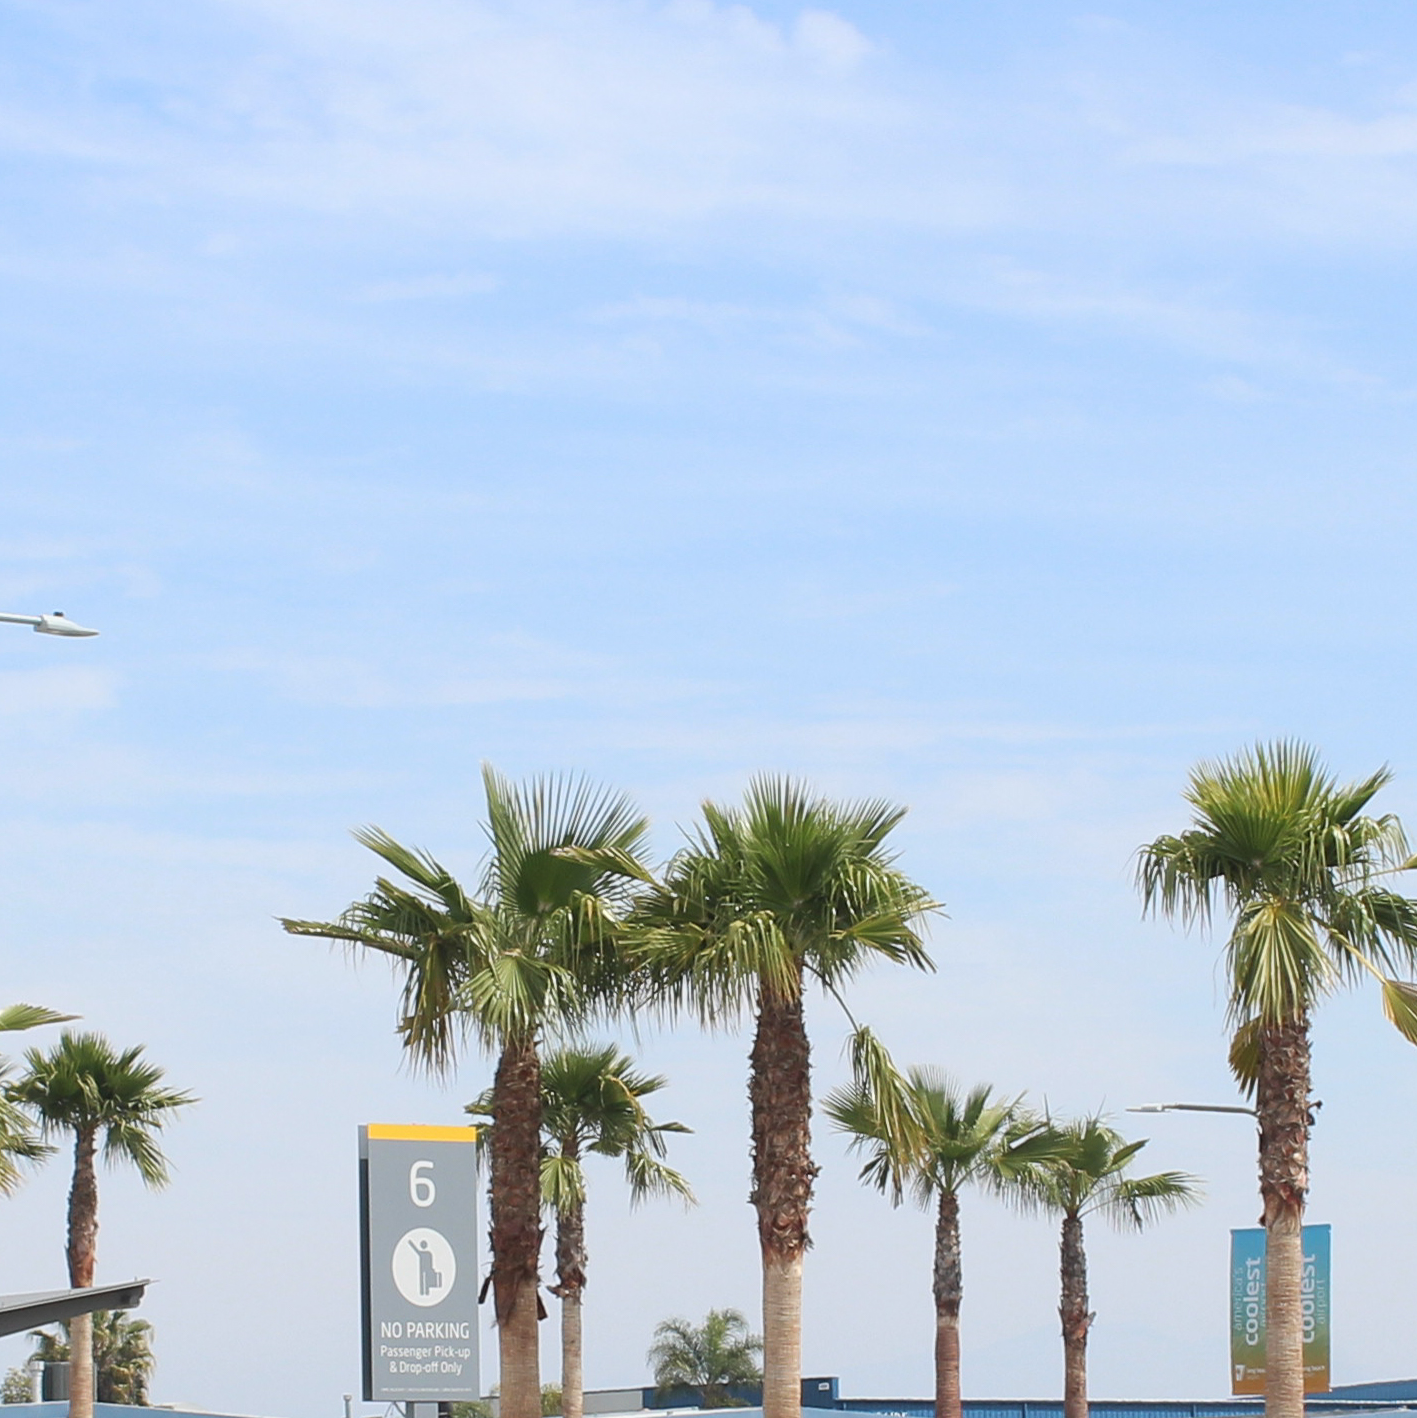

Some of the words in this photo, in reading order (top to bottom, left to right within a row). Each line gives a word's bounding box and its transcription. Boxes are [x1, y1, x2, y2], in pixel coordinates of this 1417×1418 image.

[408, 1159, 437, 1208] 6
[1243, 1257, 1262, 1346] coolest
[381, 1321, 403, 1339] NO
[406, 1321, 470, 1339] PARKING
[380, 1344, 432, 1360] Passenger
[434, 1345, 471, 1360] Pick-up
[389, 1360, 398, 1373] &
[399, 1360, 439, 1375] Drop-off
[440, 1361, 463, 1376] Only
